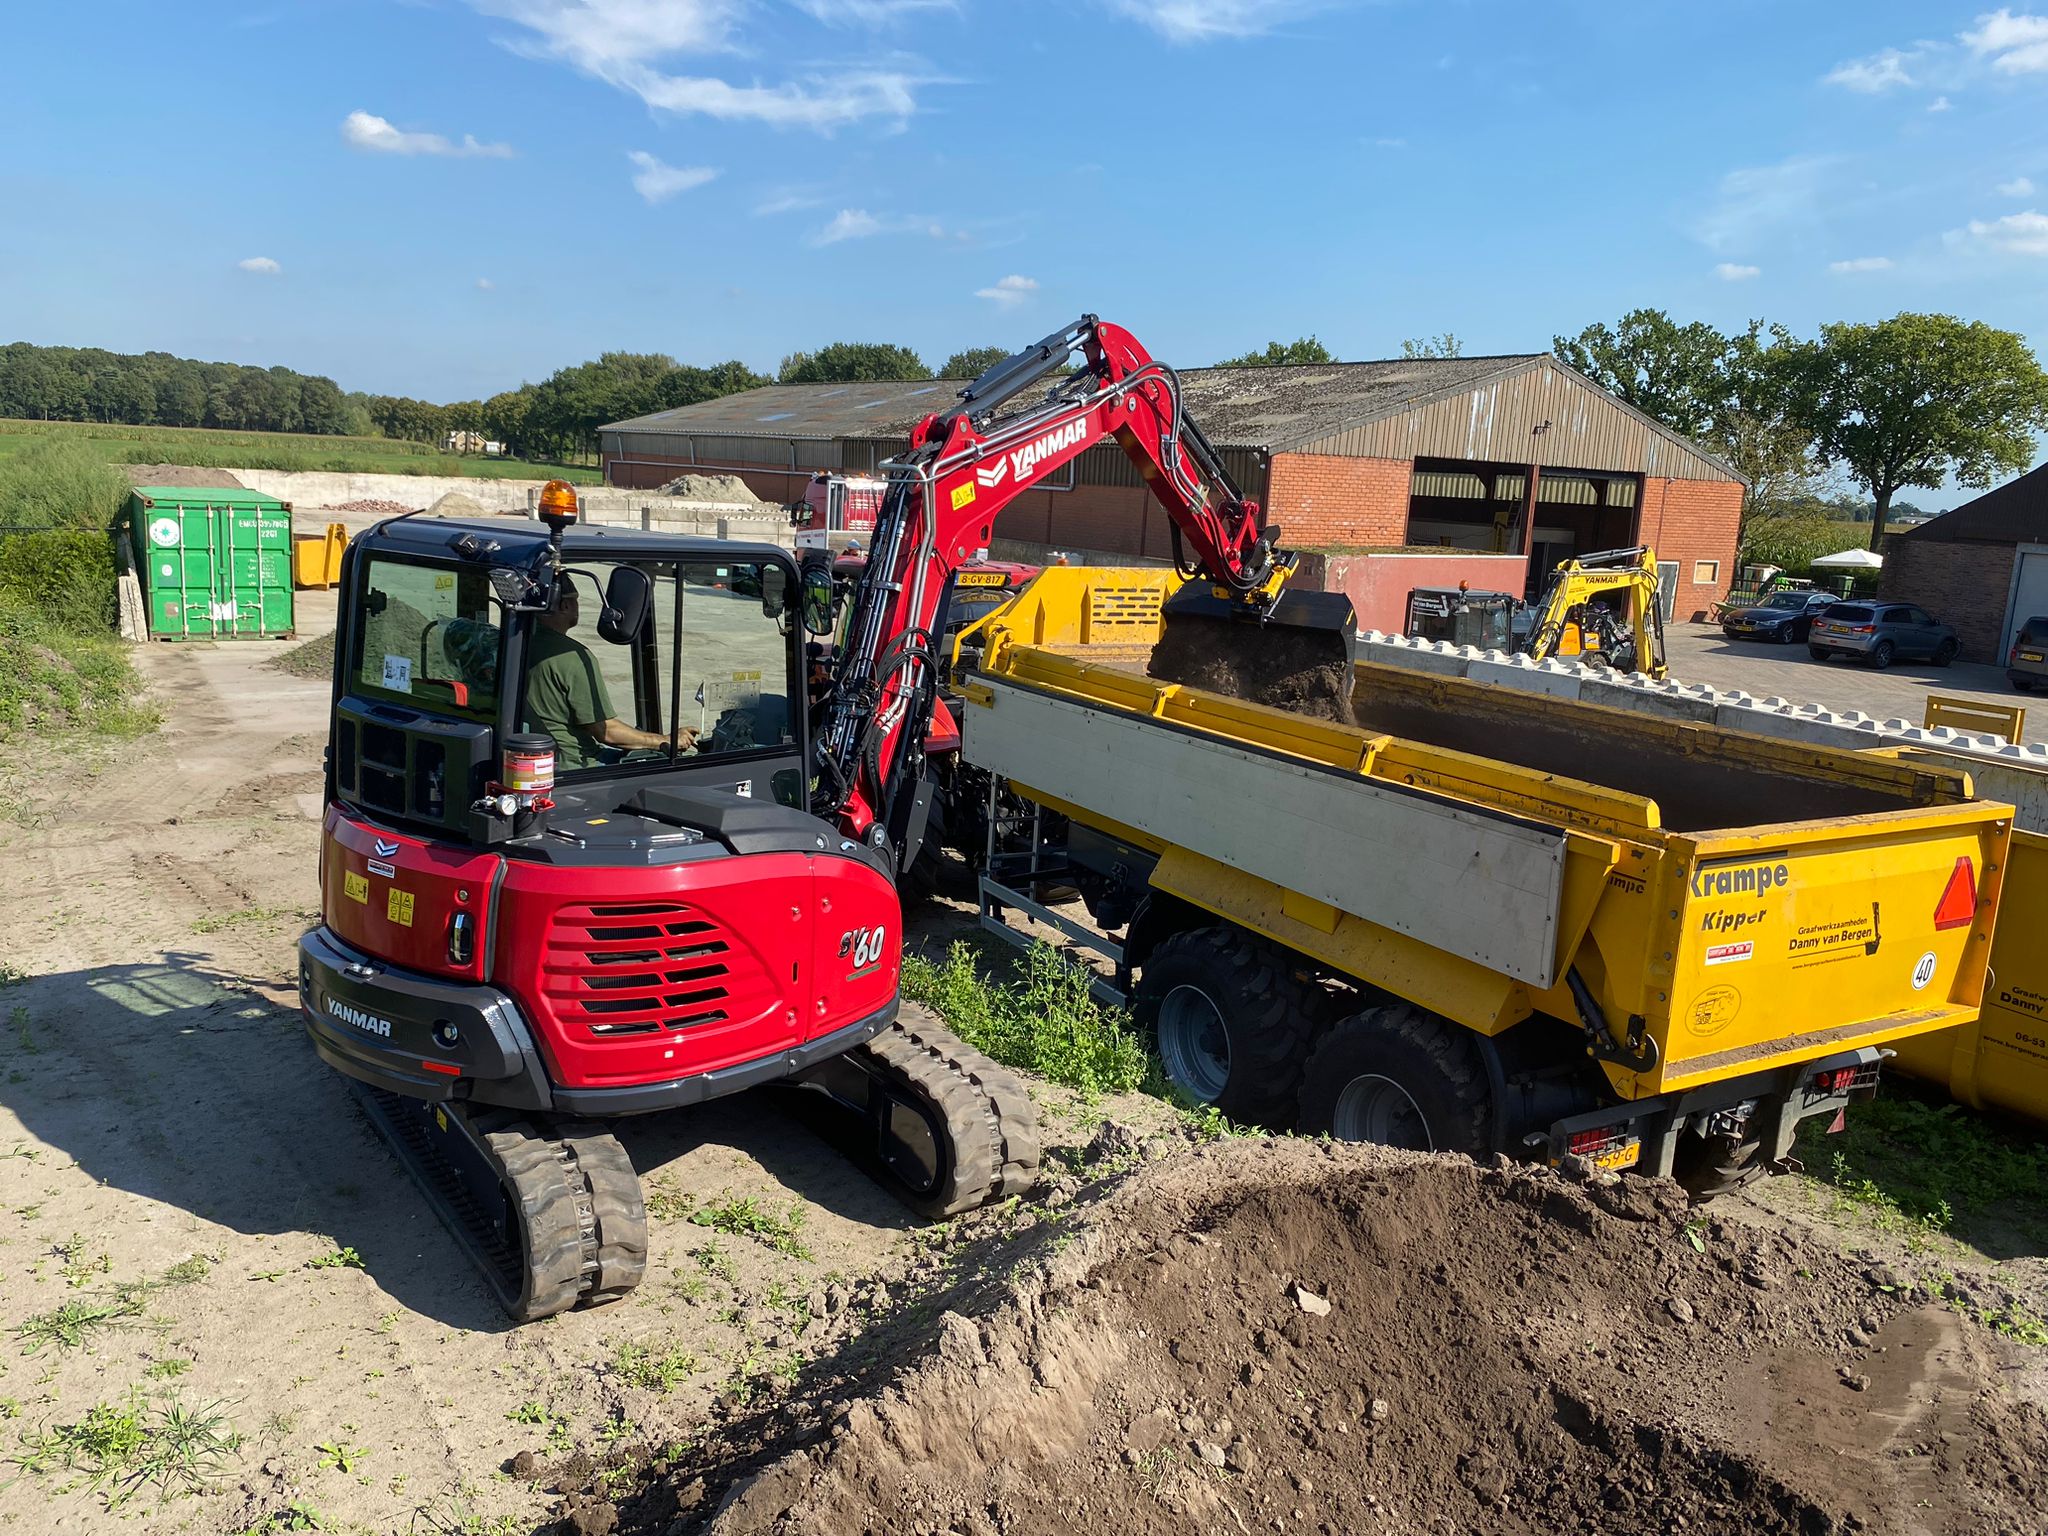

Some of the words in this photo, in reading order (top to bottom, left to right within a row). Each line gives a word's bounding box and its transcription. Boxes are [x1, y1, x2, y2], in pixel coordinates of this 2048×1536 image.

[1010, 418, 1087, 475] YANMAR
[1585, 576, 1619, 584] YANMAR
[1690, 864, 1789, 898] Krampe
[1701, 909, 1767, 933] Kipper
[1797, 917, 1868, 935] Graafwerkzaamheden
[1788, 937, 1820, 951] Danny
[1822, 934, 1840, 945] van
[1841, 928, 1872, 942] Bergen
[1915, 958, 1933, 983] 40
[2000, 991, 2044, 1014] Danny
[327, 996, 392, 1037] YANMAR
